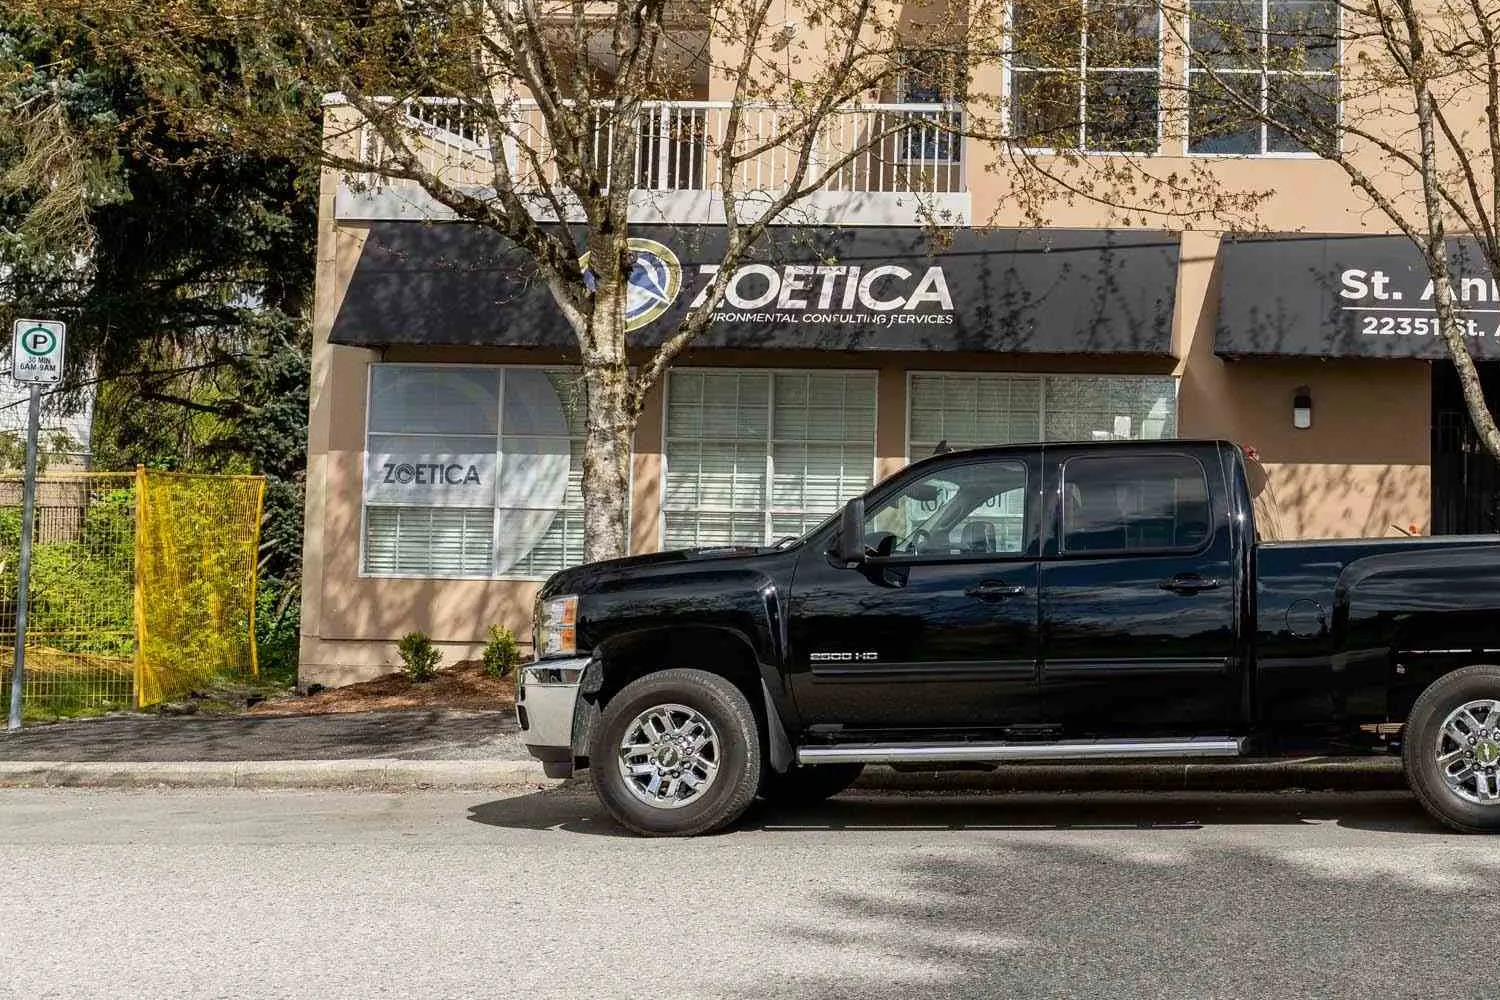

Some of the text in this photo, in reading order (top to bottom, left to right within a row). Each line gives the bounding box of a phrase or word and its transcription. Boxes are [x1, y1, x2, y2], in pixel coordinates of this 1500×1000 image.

[1340, 269, 1402, 300] St.
[686, 312, 799, 323] EIRONMENTAL
[1362, 316, 1440, 336] 22351
[33, 334, 48, 349] P
[383, 463, 481, 485] ZOETICA
